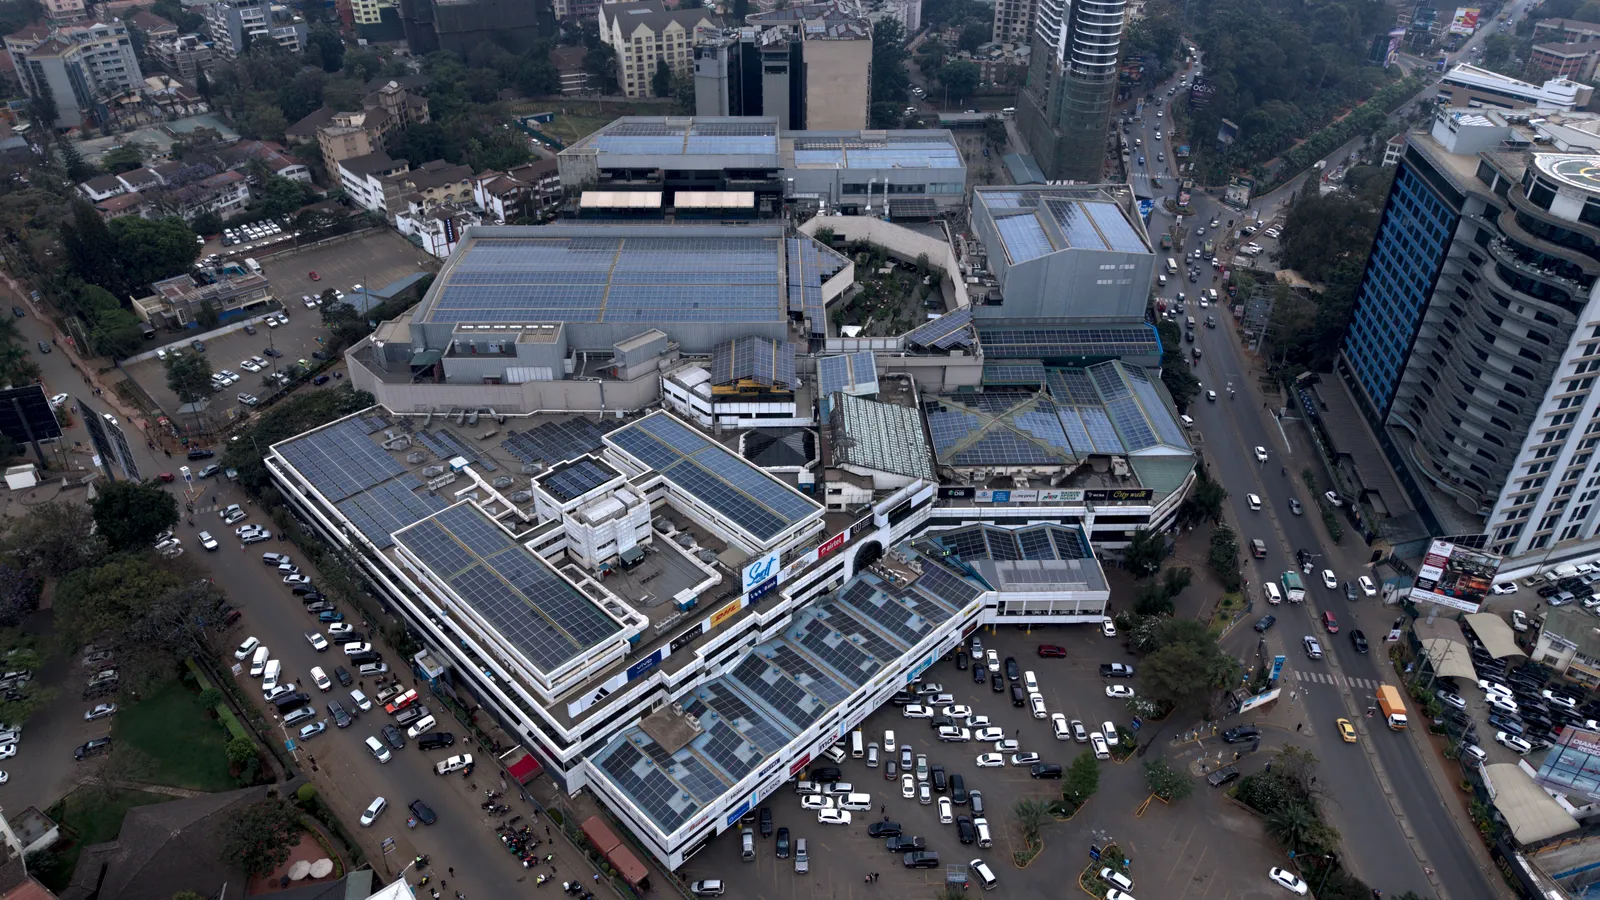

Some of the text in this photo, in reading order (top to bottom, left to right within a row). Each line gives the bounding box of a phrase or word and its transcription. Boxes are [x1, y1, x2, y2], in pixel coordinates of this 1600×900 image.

[1113, 491, 1129, 500] City
[826, 537, 842, 551] airtel
[715, 605, 737, 622] DHL
[819, 732, 838, 750] max
[761, 779, 780, 796] ALDO
